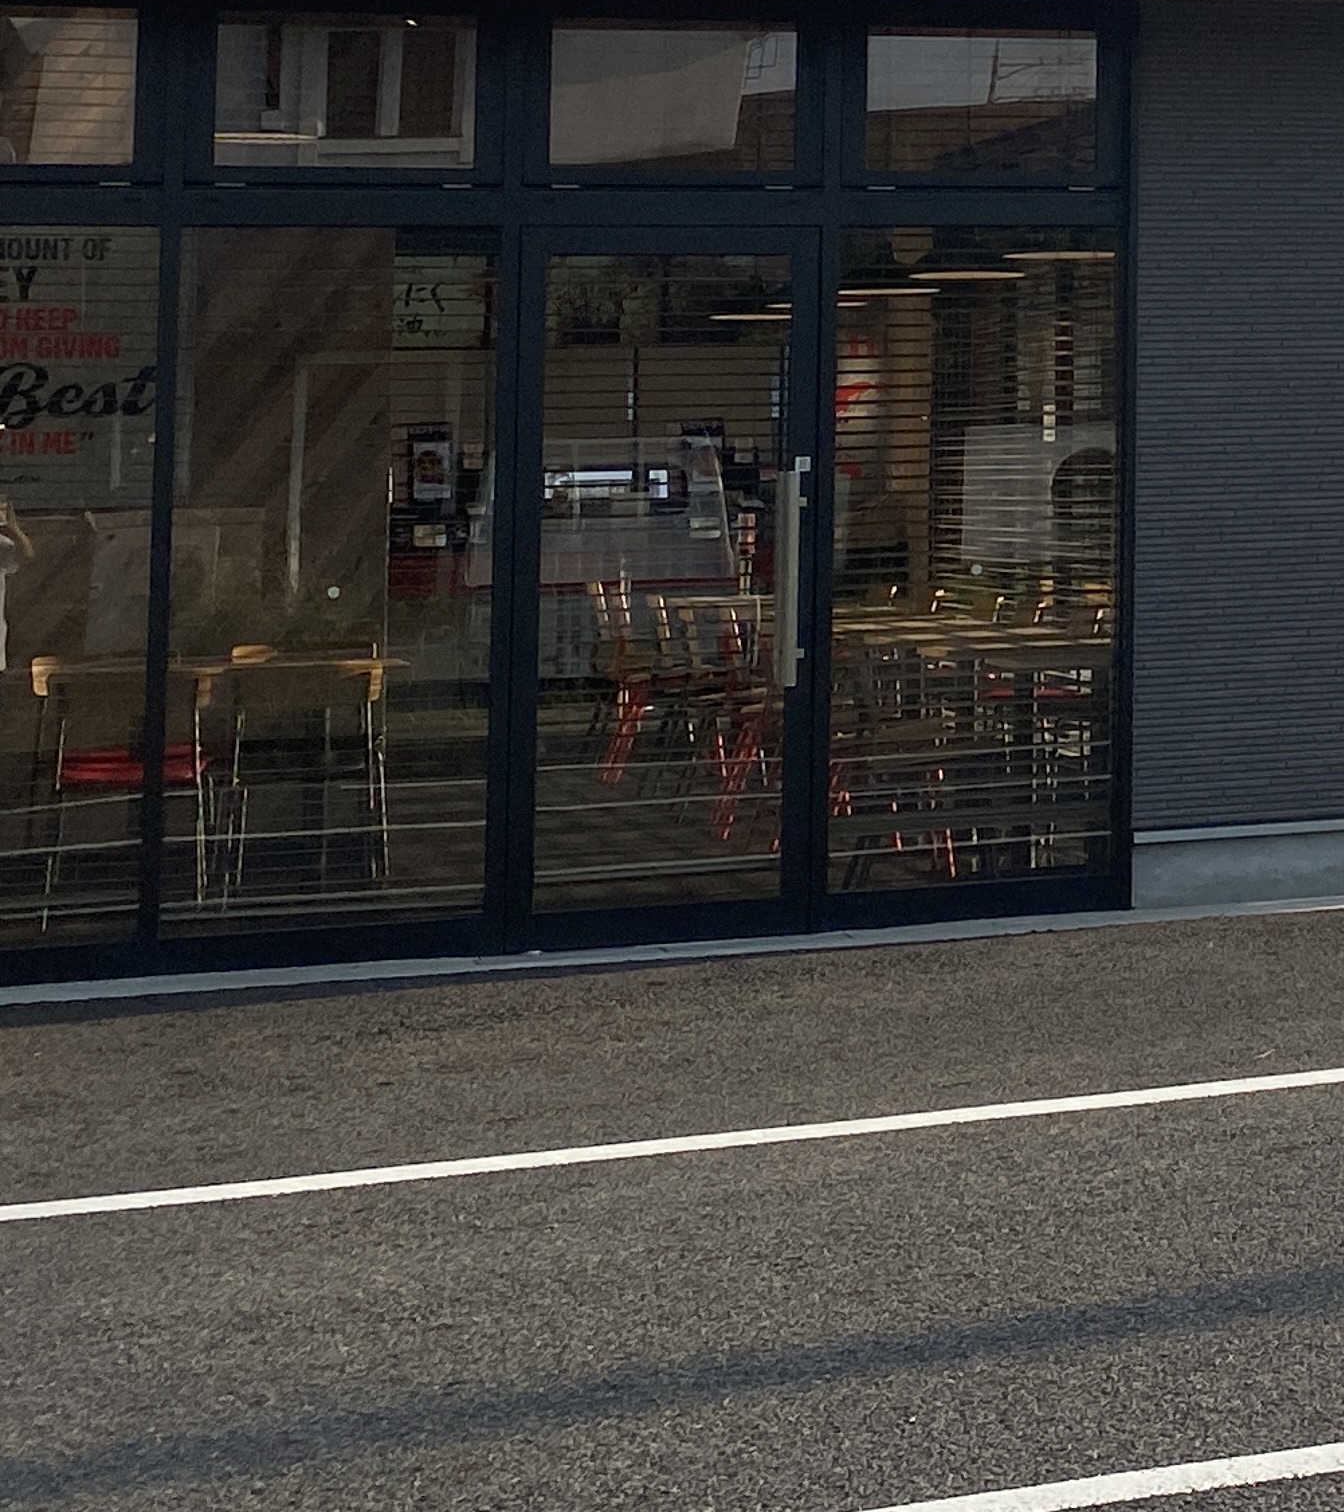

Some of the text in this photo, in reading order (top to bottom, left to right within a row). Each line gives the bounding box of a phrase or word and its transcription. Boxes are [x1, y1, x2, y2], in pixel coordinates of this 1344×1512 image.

[81, 238, 112, 261] OF
[16, 308, 78, 331] KEEP
[35, 337, 119, 359] GIVING
